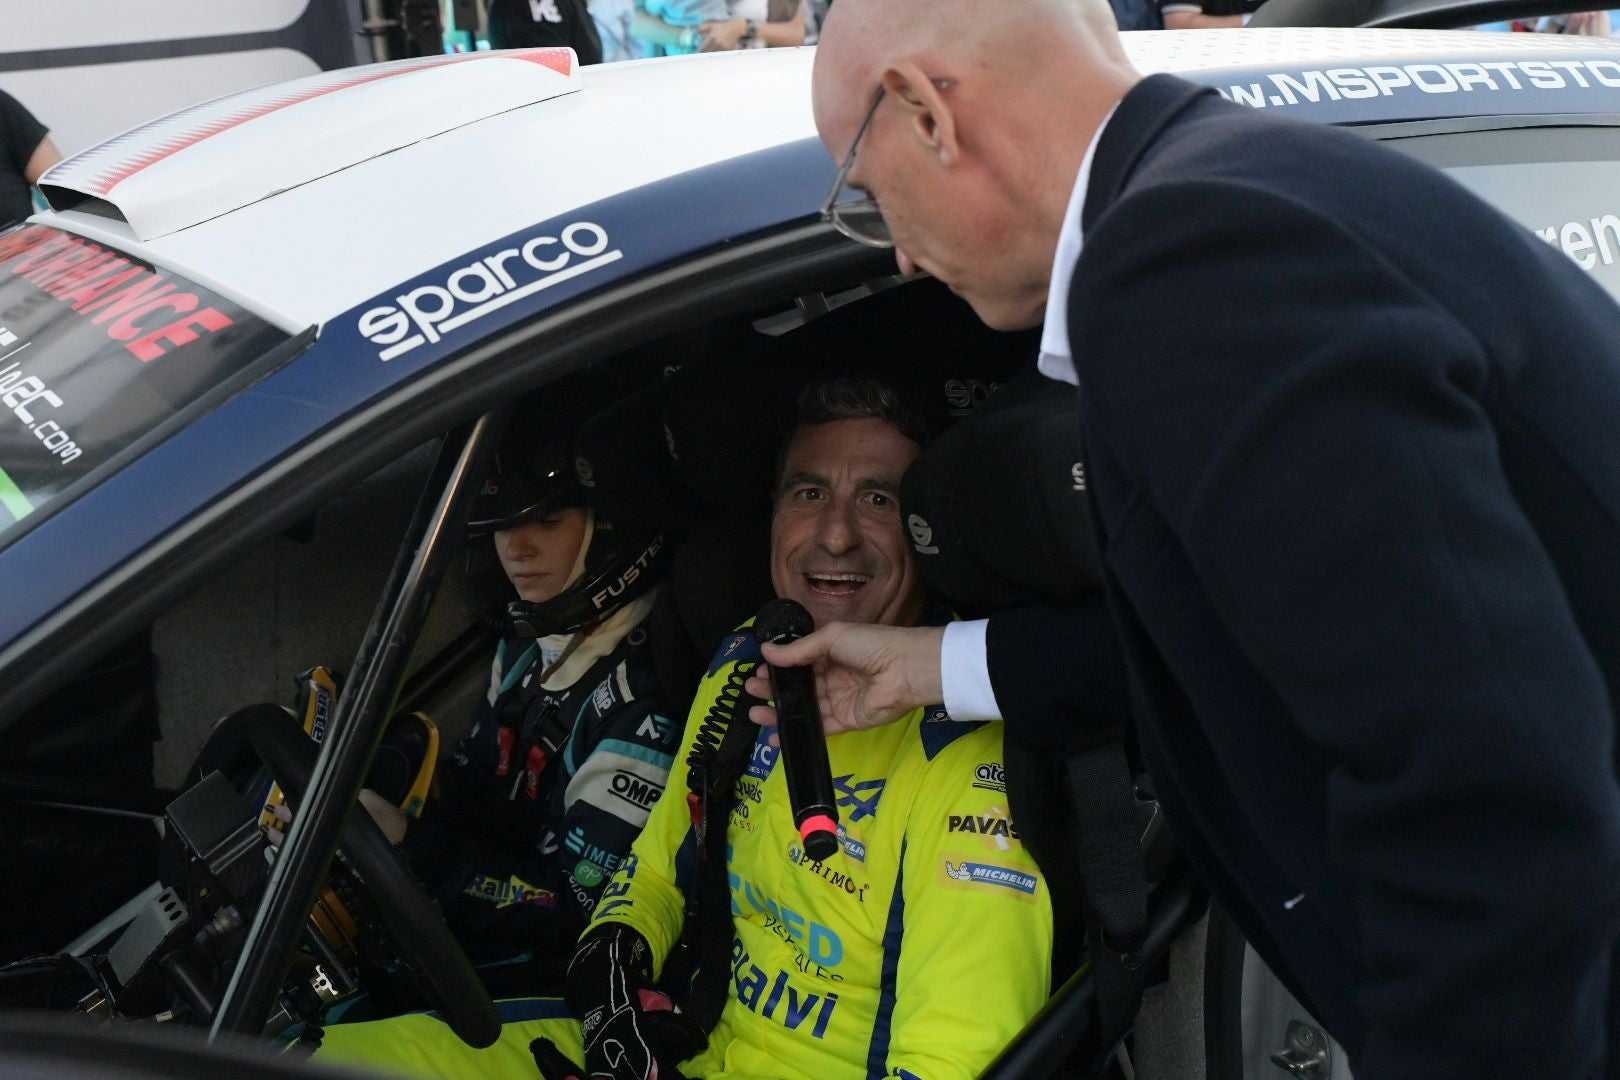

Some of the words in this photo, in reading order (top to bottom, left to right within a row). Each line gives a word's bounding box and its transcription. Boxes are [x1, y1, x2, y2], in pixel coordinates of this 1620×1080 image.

[358, 221, 609, 345] sparco
[612, 774, 662, 806] OMP
[973, 867, 1035, 889] MICHELIN
